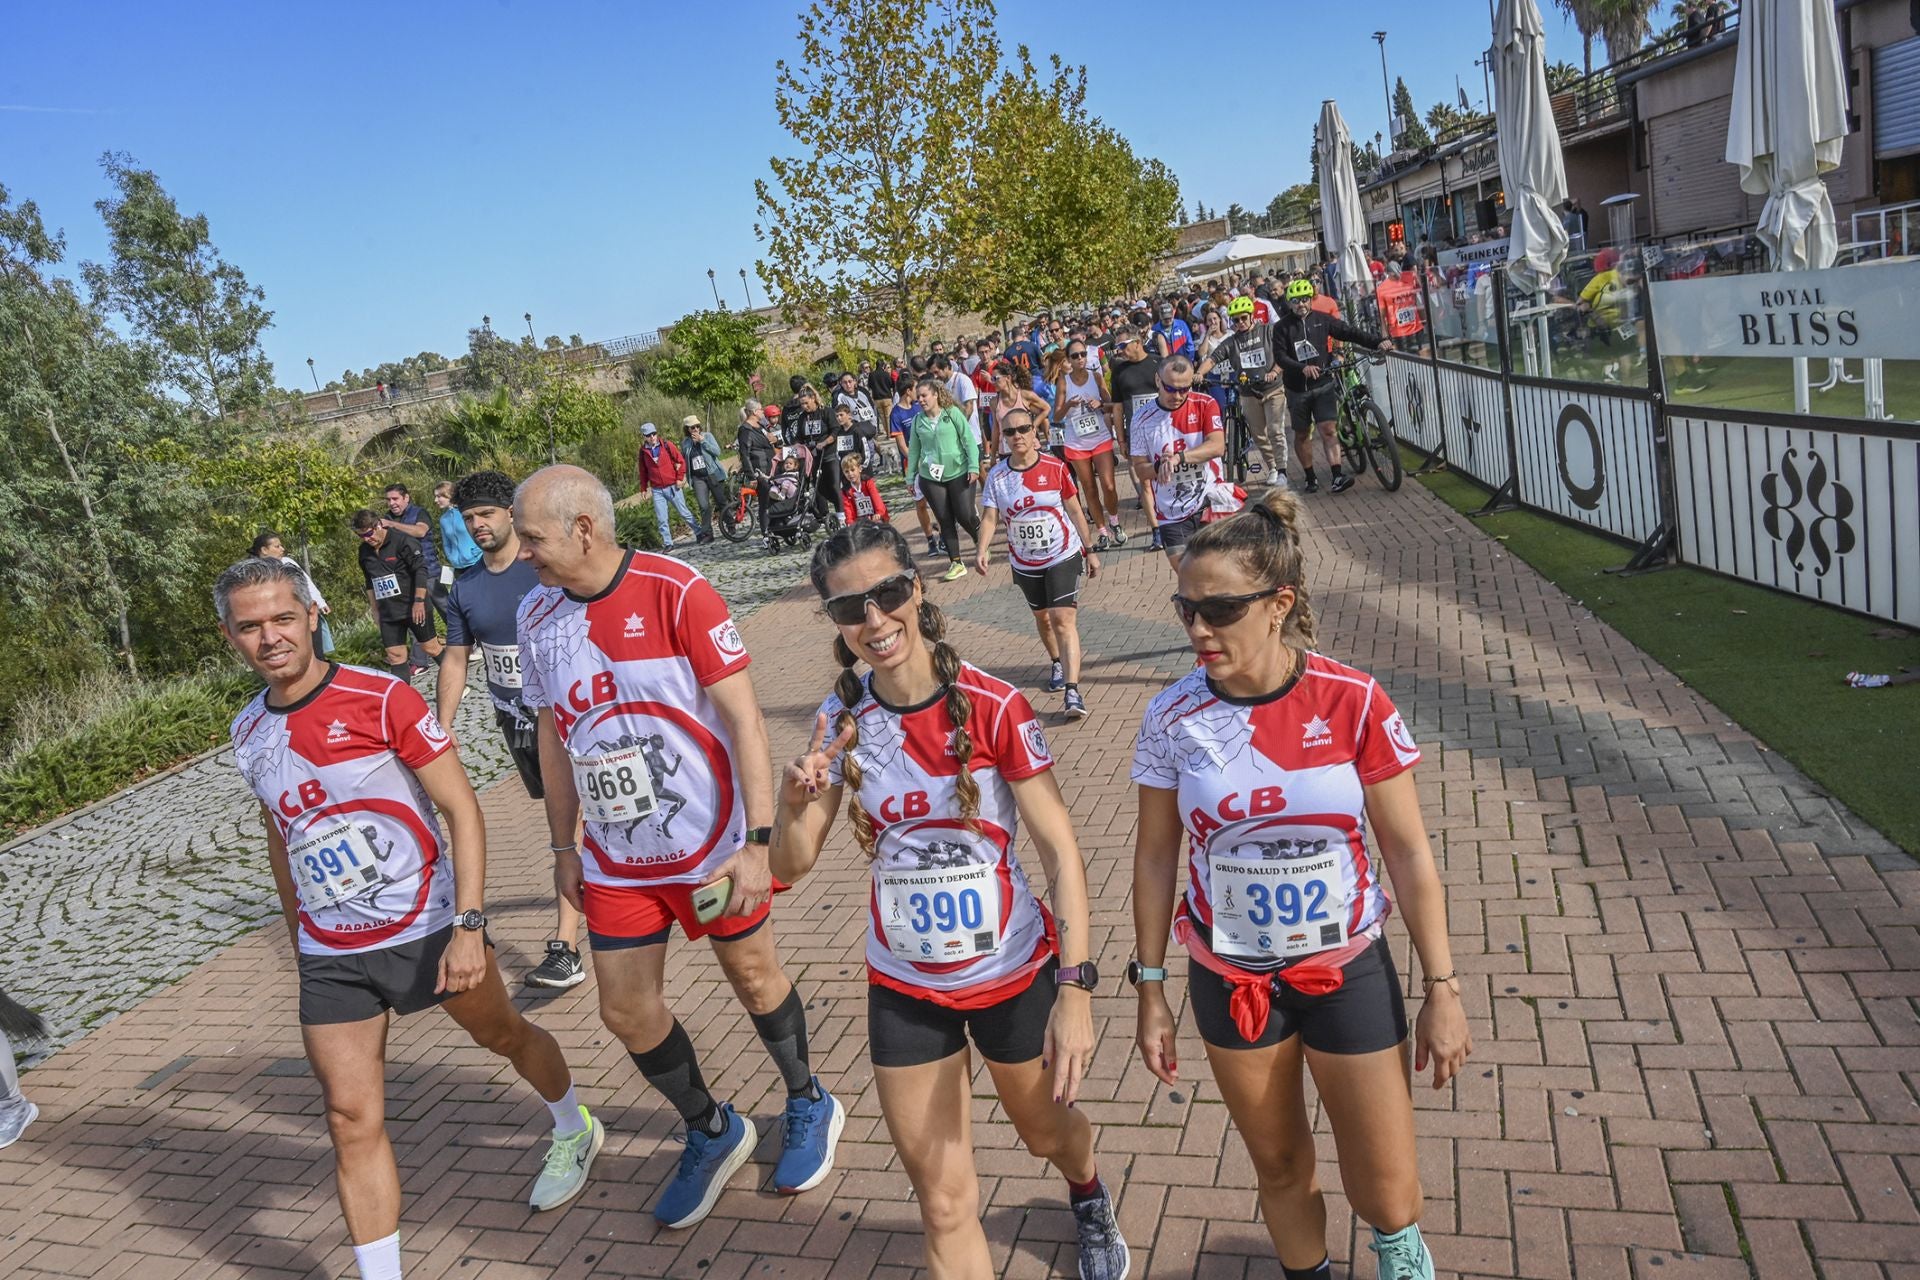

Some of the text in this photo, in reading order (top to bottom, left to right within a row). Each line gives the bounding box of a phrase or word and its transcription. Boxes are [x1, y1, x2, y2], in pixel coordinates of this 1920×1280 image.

[1461, 245, 1510, 262] HEINEKE
[1760, 287, 1825, 308] ROYAL
[1738, 310, 1859, 347] BLISS
[1079, 416, 1097, 429] 556
[1019, 525, 1044, 540] 593
[377, 580, 395, 592] 560
[1302, 736, 1333, 749] luanvi
[586, 766, 638, 801] 968
[304, 839, 361, 884] 391
[625, 849, 687, 864] BADAJOZ
[1215, 863, 1246, 874] GRUPO
[1247, 867, 1280, 875] SALUD
[1291, 859, 1335, 874] DEPORTE
[884, 878, 909, 886] GRUPO
[910, 877, 937, 886] SALUD
[946, 870, 987, 883] DEPORTE
[909, 888, 983, 933] 390
[1246, 879, 1329, 926] 392
[335, 916, 395, 931] BADAJOZ
